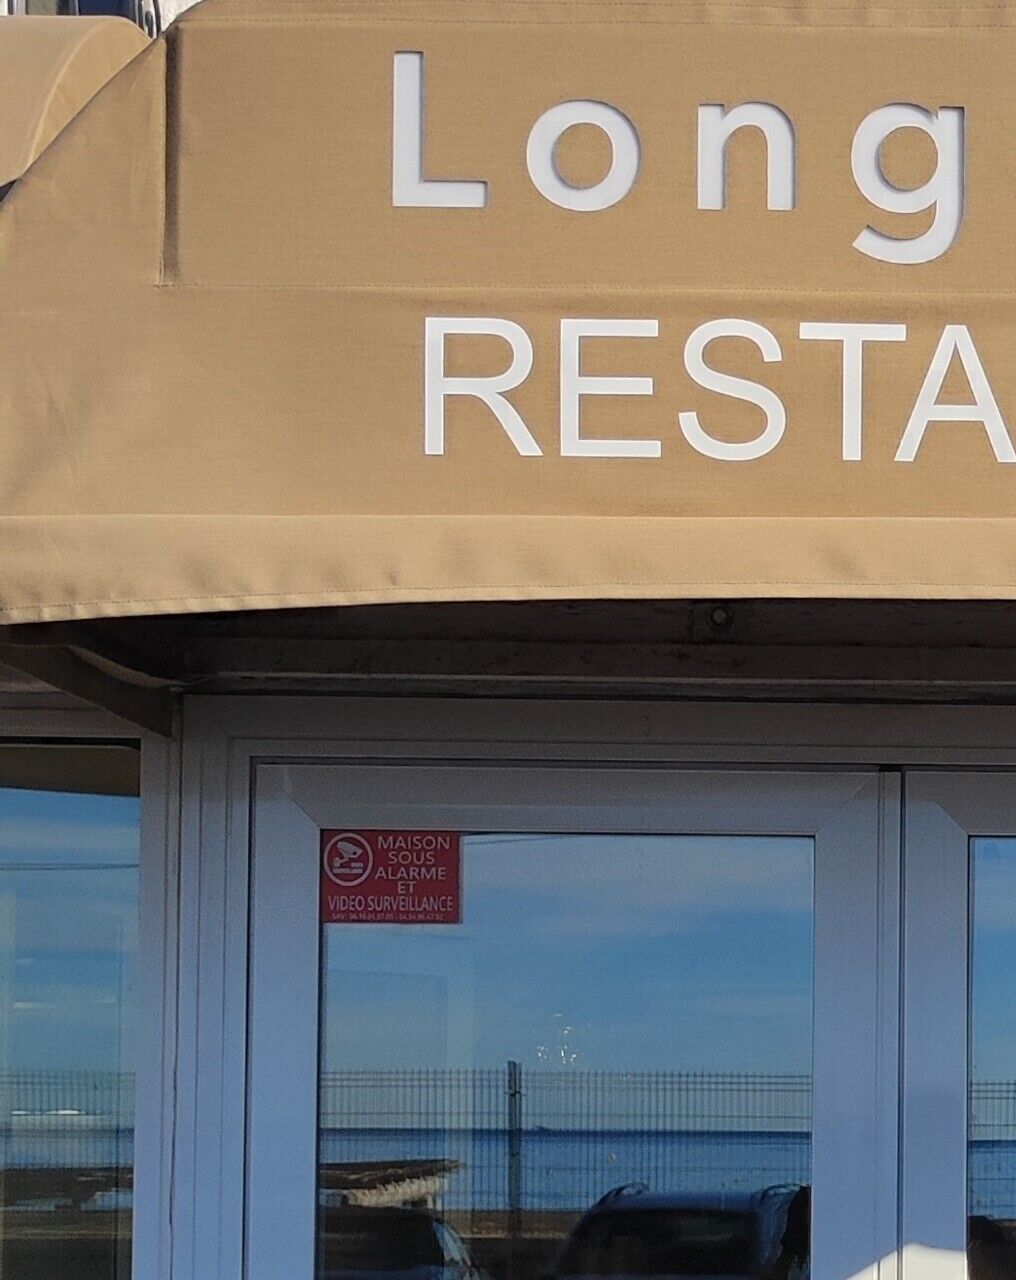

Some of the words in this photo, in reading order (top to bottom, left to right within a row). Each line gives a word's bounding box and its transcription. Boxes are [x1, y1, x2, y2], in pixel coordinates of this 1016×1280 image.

[377, 836, 449, 849] MAISON
[388, 851, 435, 865] SOUS
[375, 867, 447, 880] ALARME
[397, 881, 416, 894] ET
[328, 896, 365, 911] VIDEO
[367, 896, 453, 911] SURVEILLANCE
